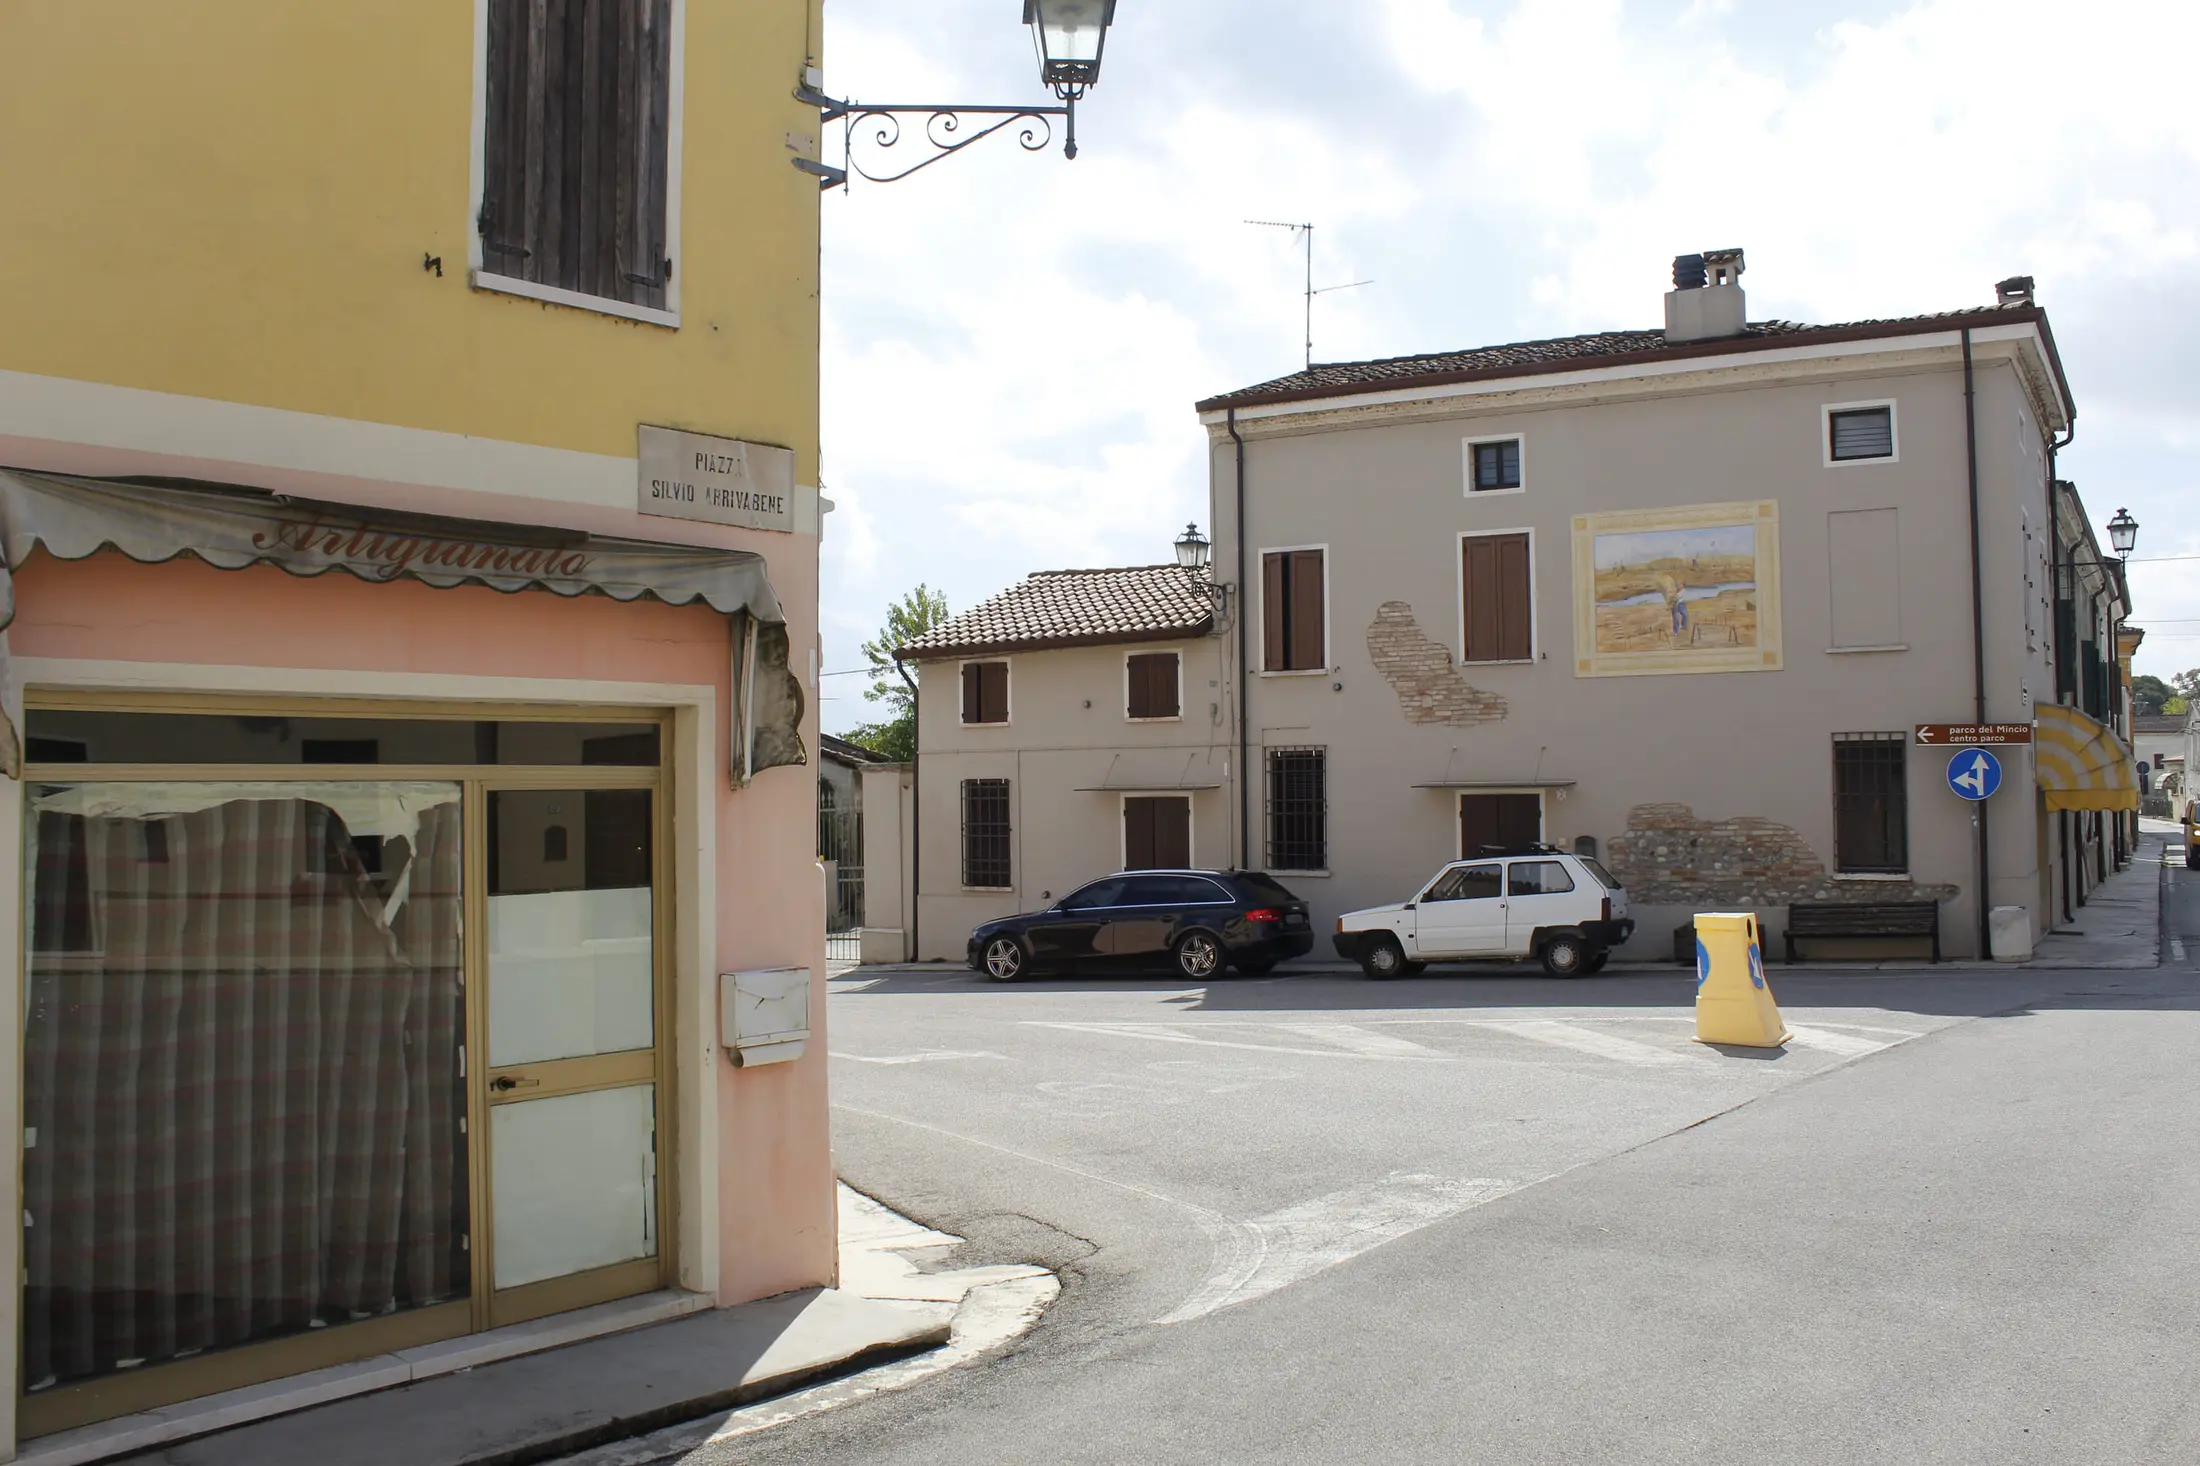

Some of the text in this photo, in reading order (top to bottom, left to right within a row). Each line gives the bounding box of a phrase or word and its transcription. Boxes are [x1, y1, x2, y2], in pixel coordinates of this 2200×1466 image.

[652, 479, 784, 515] SILVIO ARRIVABENE
[1949, 725, 2028, 735] parco del Mincio
